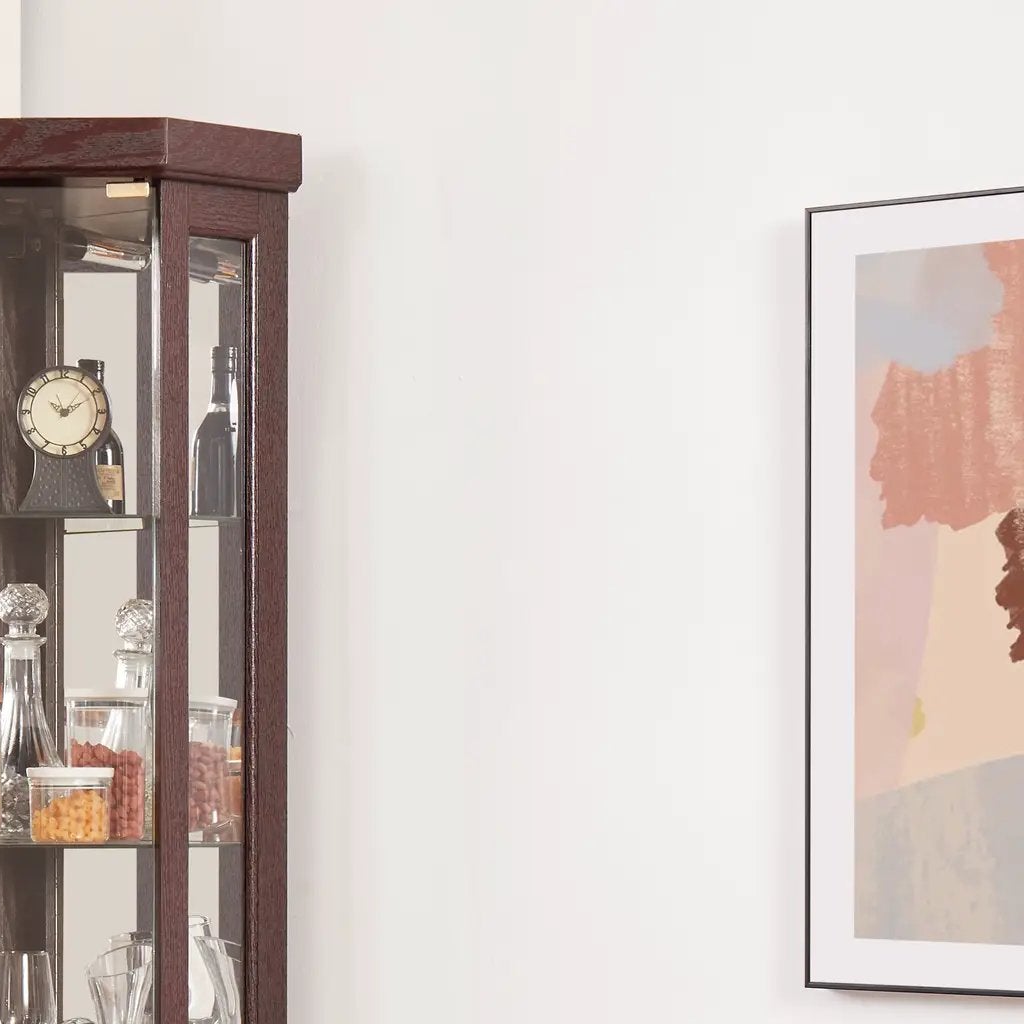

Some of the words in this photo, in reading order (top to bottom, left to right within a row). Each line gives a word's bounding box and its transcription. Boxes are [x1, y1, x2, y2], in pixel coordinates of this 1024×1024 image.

[60, 369, 70, 379] 12
[41, 374, 50, 384] 11
[26, 387, 36, 397] 10
[92, 387, 101, 396] 2
[27, 427, 36, 435] 8
[93, 426, 100, 435] 4
[41, 440, 50, 449] 7
[79, 441, 88, 450] 5
[62, 445, 67, 456] 6
